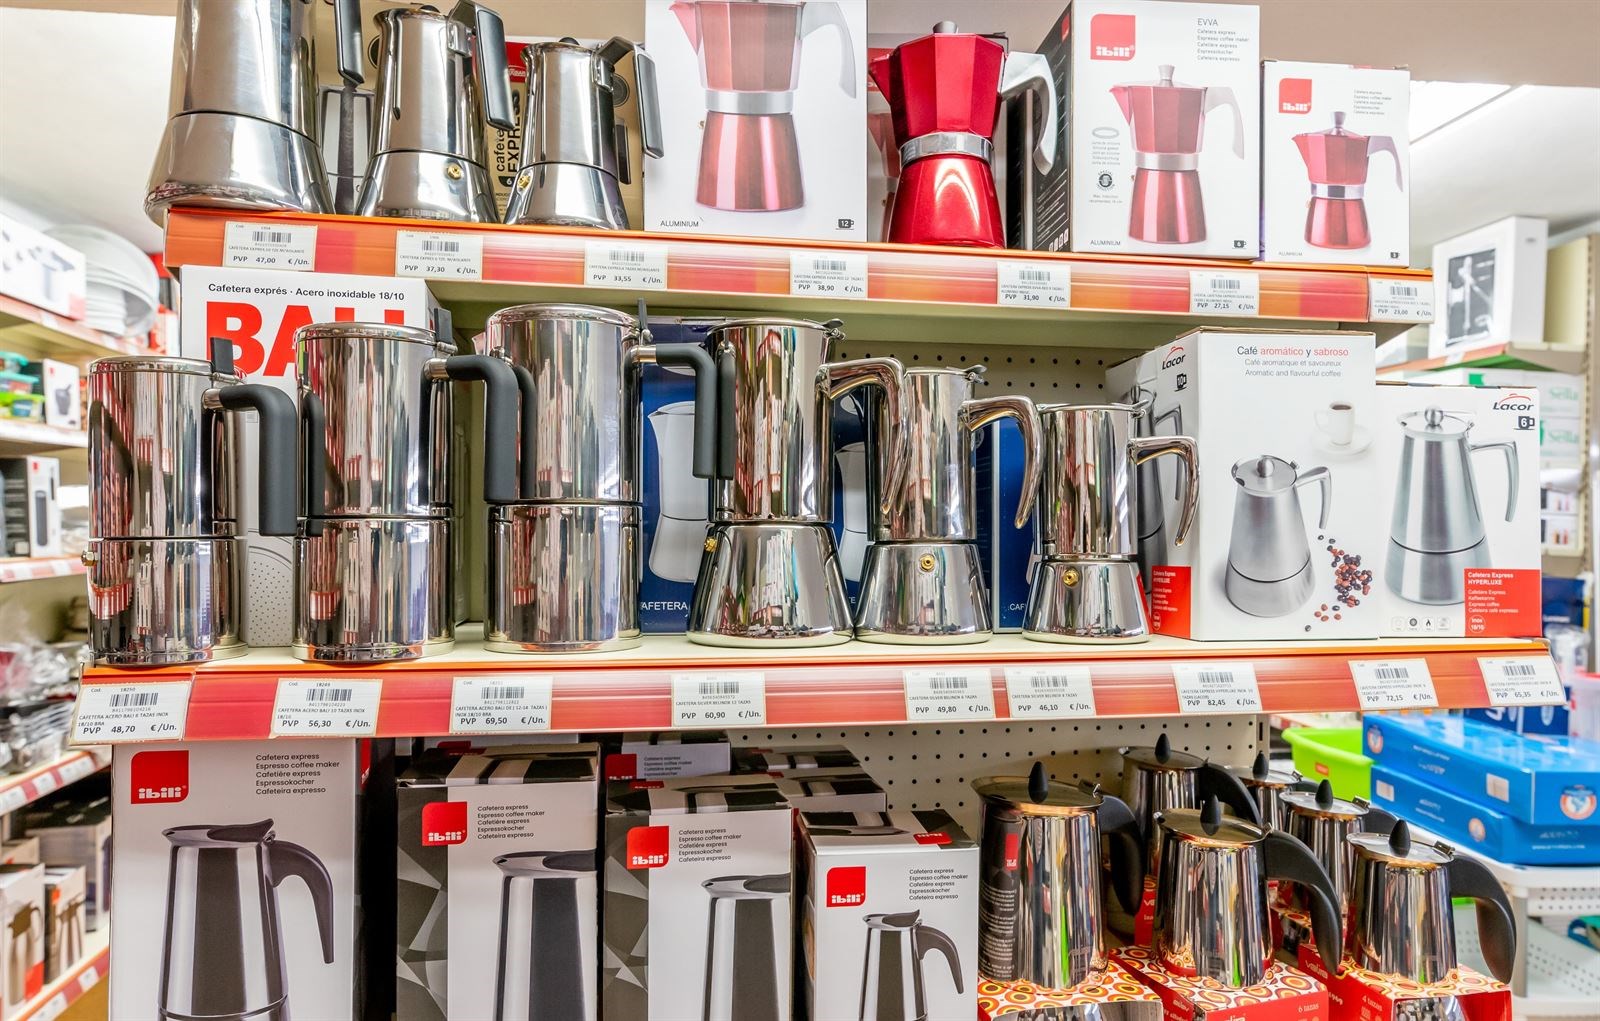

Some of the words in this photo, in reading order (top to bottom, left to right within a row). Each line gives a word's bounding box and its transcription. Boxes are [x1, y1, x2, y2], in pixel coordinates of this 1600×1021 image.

[1197, 18, 1218, 26] EVVA
[1096, 45, 1130, 57] ibili
[660, 220, 699, 228] ALUMINIUM
[426, 265, 445, 273] 37,30
[208, 283, 252, 294] Cafetera
[254, 285, 288, 296] exprés
[295, 288, 324, 297] Acero
[326, 288, 376, 300] inoxidable
[378, 291, 405, 301] 18/10
[817, 284, 835, 292] 38,90
[1023, 294, 1040, 302] 31,90
[1237, 345, 1258, 356] Café
[1260, 345, 1304, 356] aromático
[1306, 348, 1312, 358] y
[1314, 346, 1349, 356] sabroso
[1162, 354, 1186, 370] Lacor
[1261, 359, 1299, 368] aromatique
[1492, 402, 1534, 411] Lacor
[1521, 418, 1528, 427] 6
[640, 601, 688, 610] AFETERA
[1514, 691, 1531, 699] 65,35
[937, 705, 957, 713] 49,80
[1039, 704, 1058, 712] 46,10
[705, 711, 726, 720] 60,90
[308, 720, 332, 728] 56,30
[460, 717, 477, 725] PVP
[485, 717, 508, 726] 69,50
[111, 725, 136, 734] 48,70
[150, 724, 157, 732] €
[255, 753, 290, 761] Cafetera
[290, 753, 320, 761] express
[255, 762, 289, 770] Espresso
[290, 761, 314, 769] coffee
[315, 760, 340, 768] maker
[292, 770, 321, 778] express
[255, 778, 314, 787] Espressokocher
[138, 786, 182, 800] ibili
[292, 787, 326, 795] expresso
[505, 804, 529, 812] express
[477, 825, 525, 833] Espressokocher
[428, 832, 462, 842] ibili
[678, 848, 723, 856] Espressokocher
[632, 854, 664, 865] ibili
[831, 894, 860, 904] ibili
